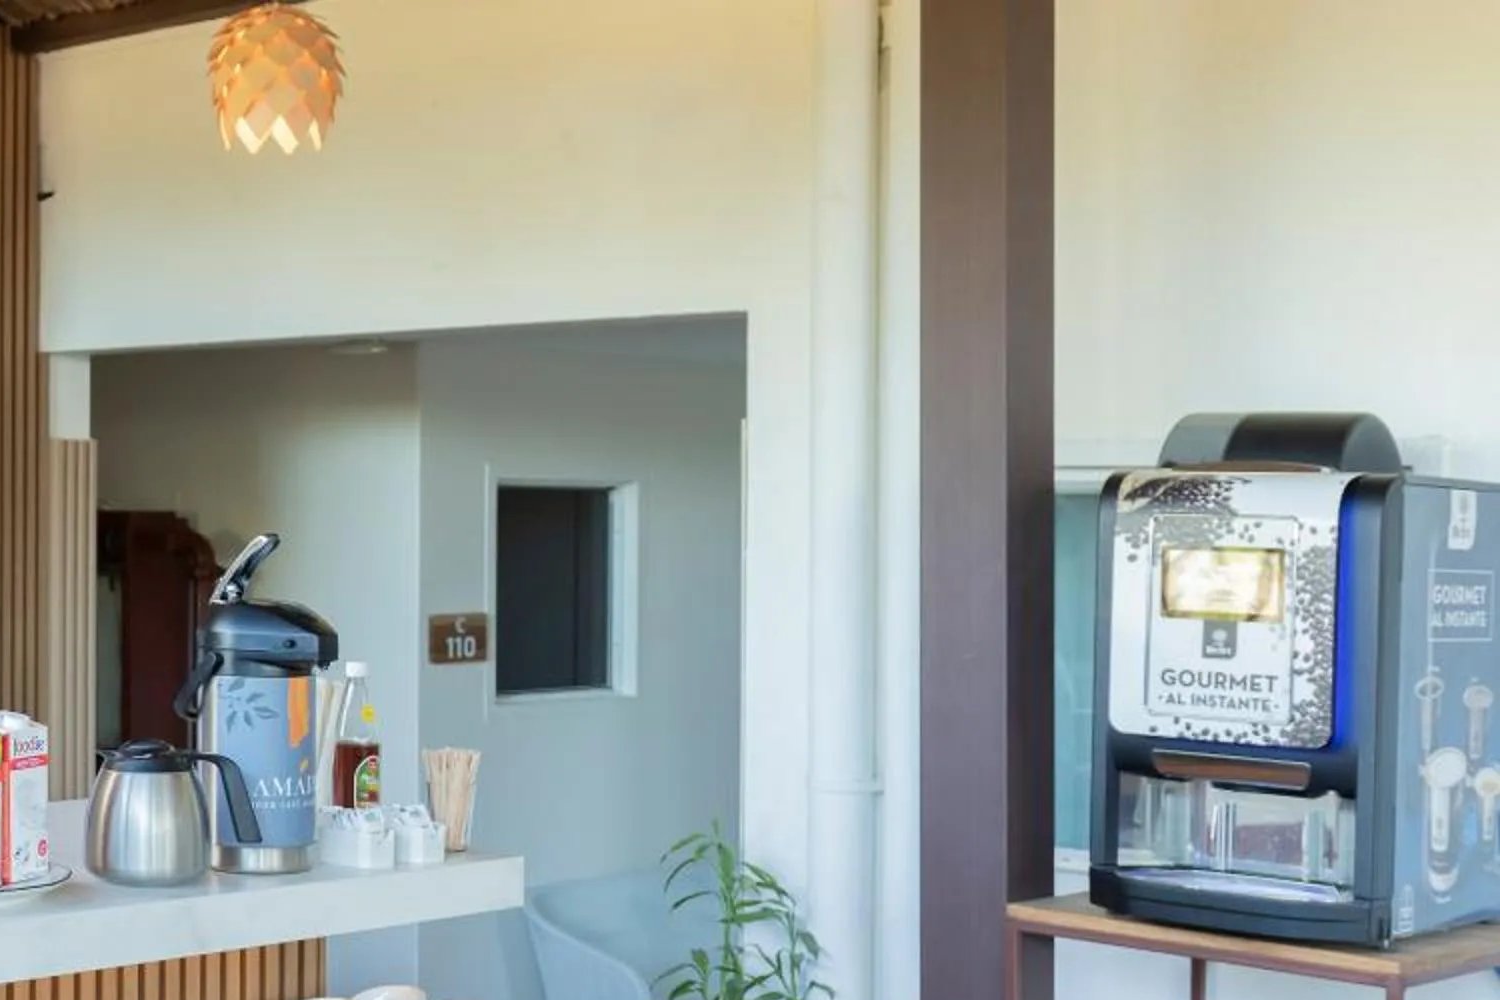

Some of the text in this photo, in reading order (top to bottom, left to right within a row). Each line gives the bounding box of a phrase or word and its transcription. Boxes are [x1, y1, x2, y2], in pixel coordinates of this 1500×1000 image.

[455, 616, 467, 634] C
[445, 636, 477, 660] 110
[1160, 667, 1279, 693] GOURMET
[1164, 692, 1272, 713] AL INSTANTE
